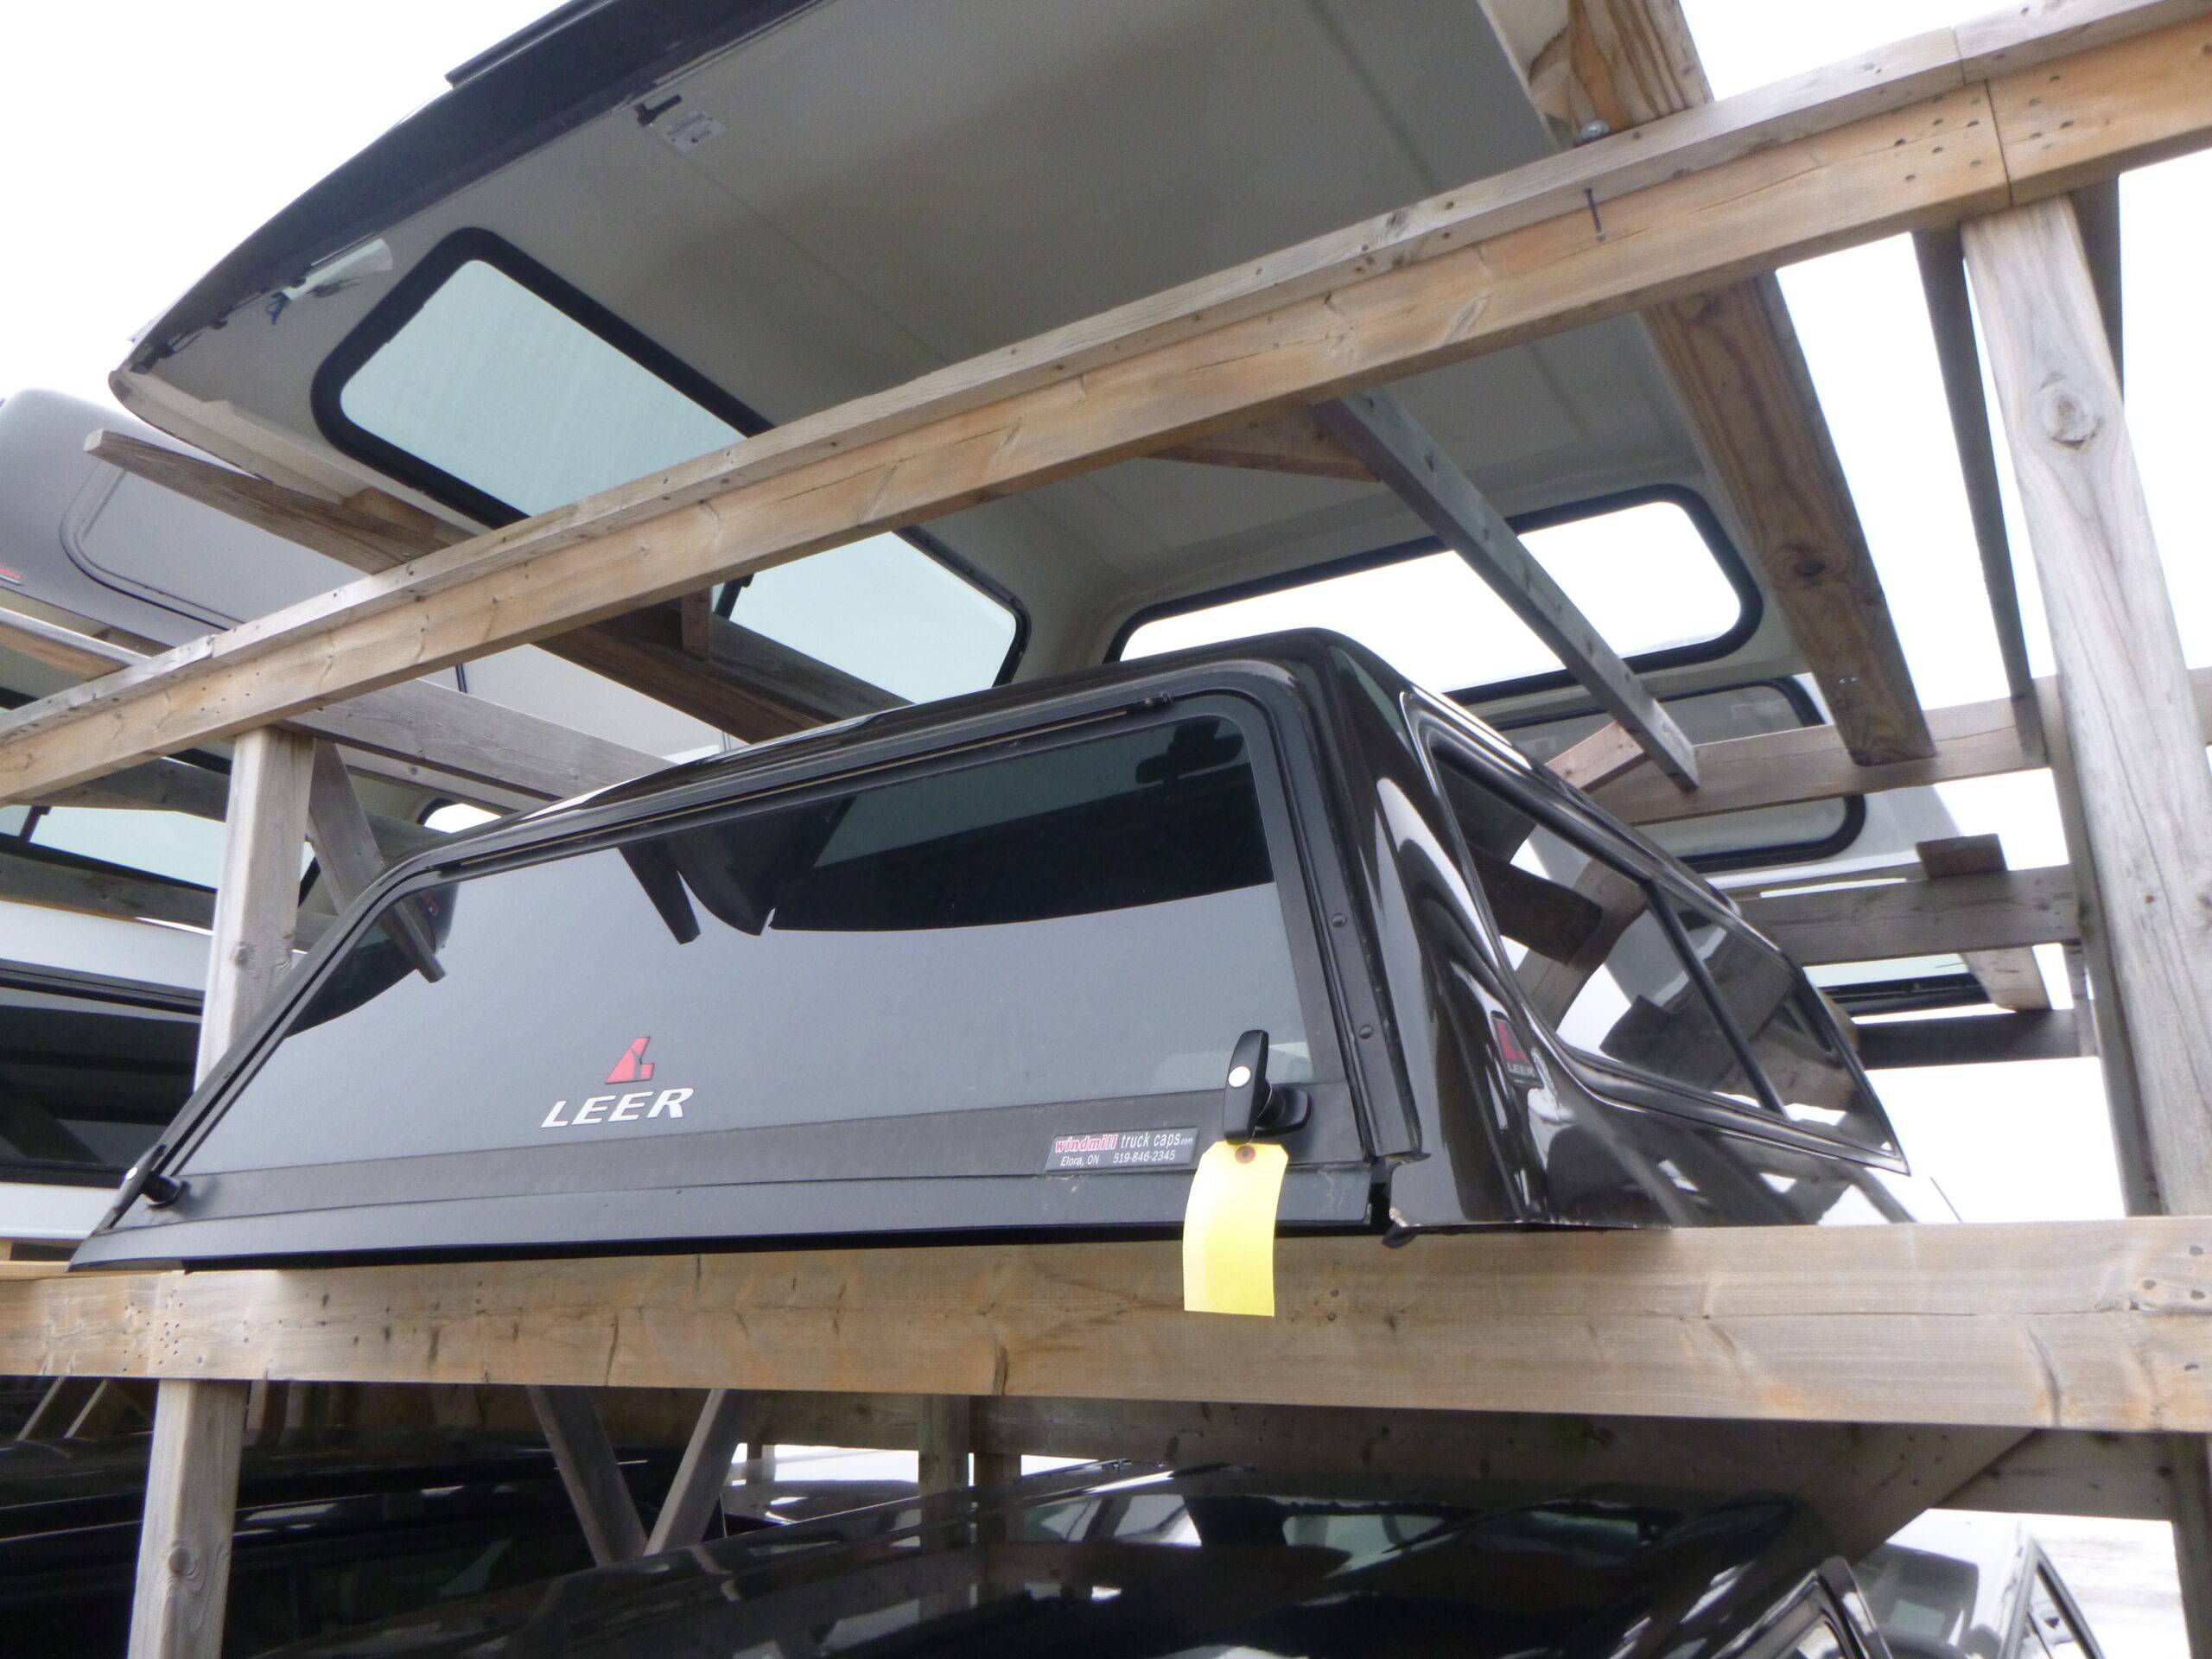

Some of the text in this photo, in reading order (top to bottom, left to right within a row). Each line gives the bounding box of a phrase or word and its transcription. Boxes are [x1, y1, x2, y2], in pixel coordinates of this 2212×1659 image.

[1506, 1063, 1535, 1077] LEER
[541, 1088, 694, 1128] LEER
[1055, 1134, 1118, 1153] windmill
[1121, 1132, 1149, 1148] truck
[1060, 1149, 1176, 1166] Elora, ON 519-846-2345
